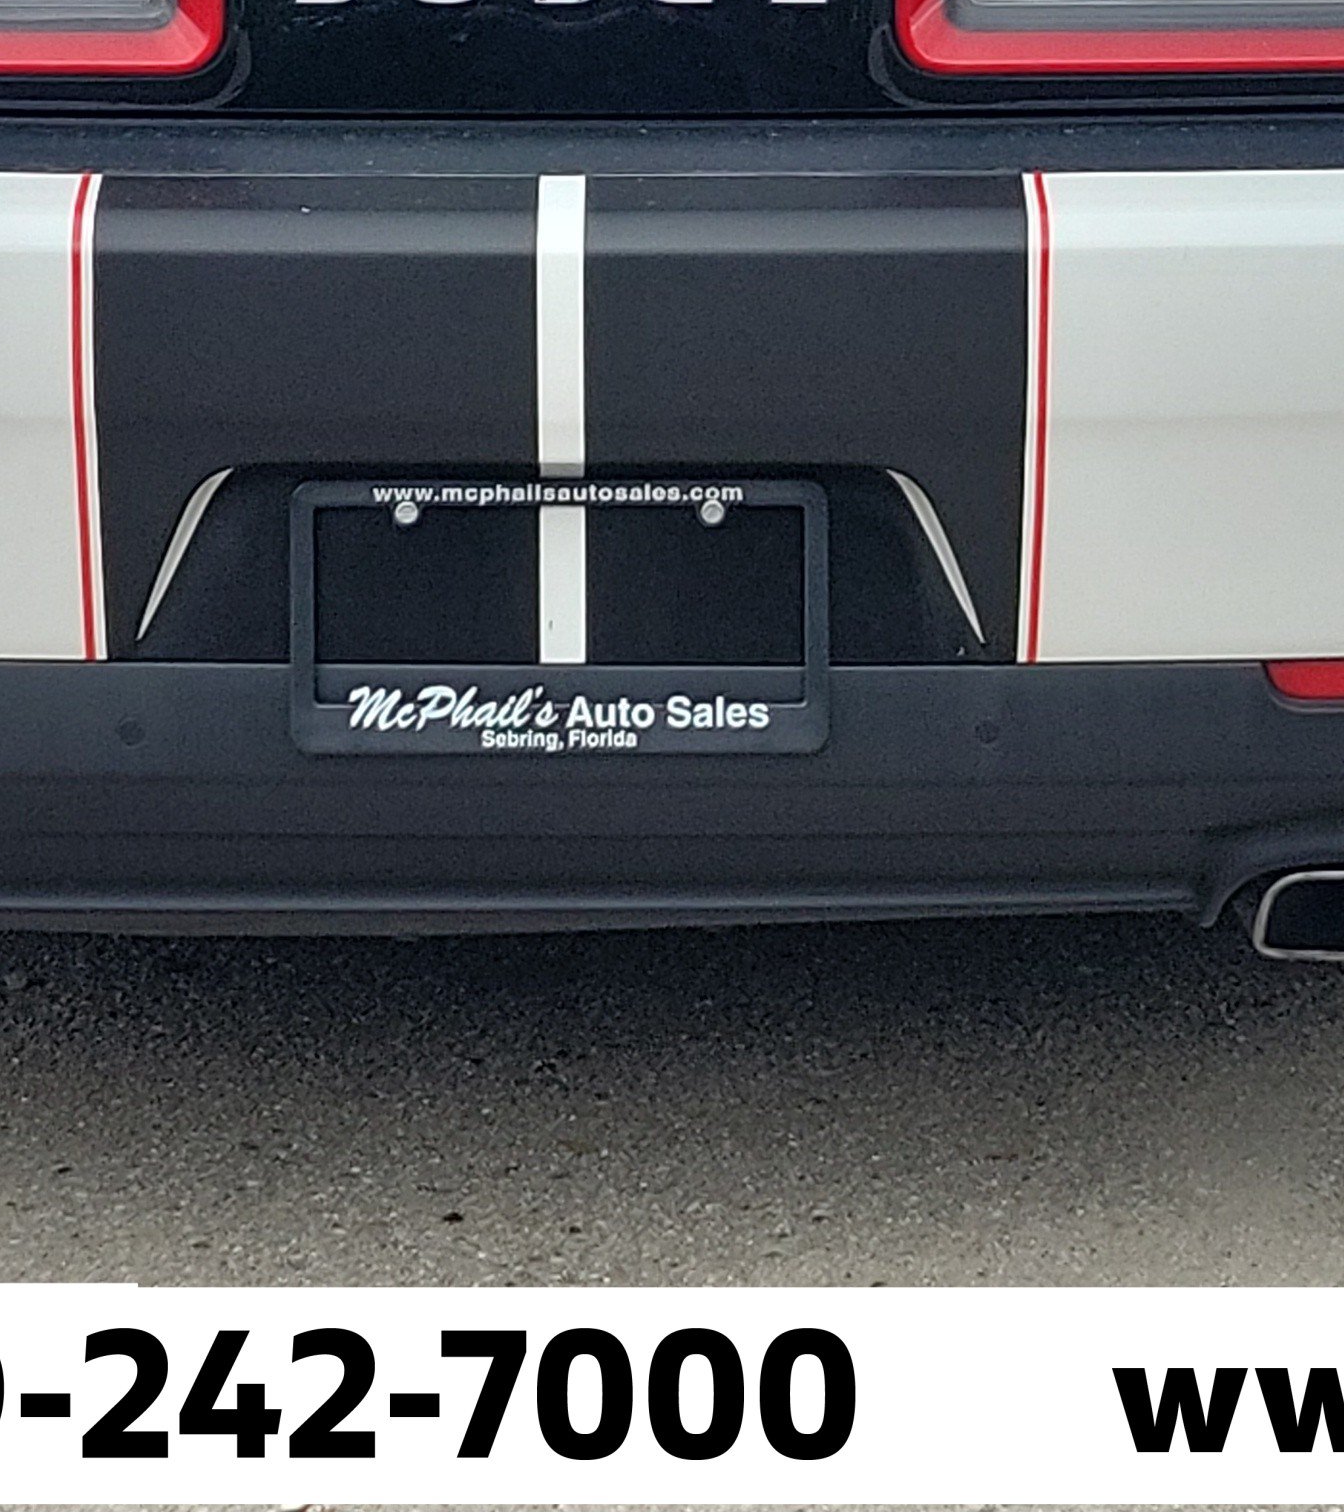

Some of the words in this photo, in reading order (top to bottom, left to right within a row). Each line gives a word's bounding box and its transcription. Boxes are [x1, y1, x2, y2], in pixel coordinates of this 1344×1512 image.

[372, 483, 744, 505] www.mcphailsautosales.com
[348, 685, 558, 733] McPhail's
[565, 697, 656, 729] Auto
[666, 695, 770, 729] Sales
[481, 729, 564, 752] Sebring,
[567, 729, 638, 749] Florida
